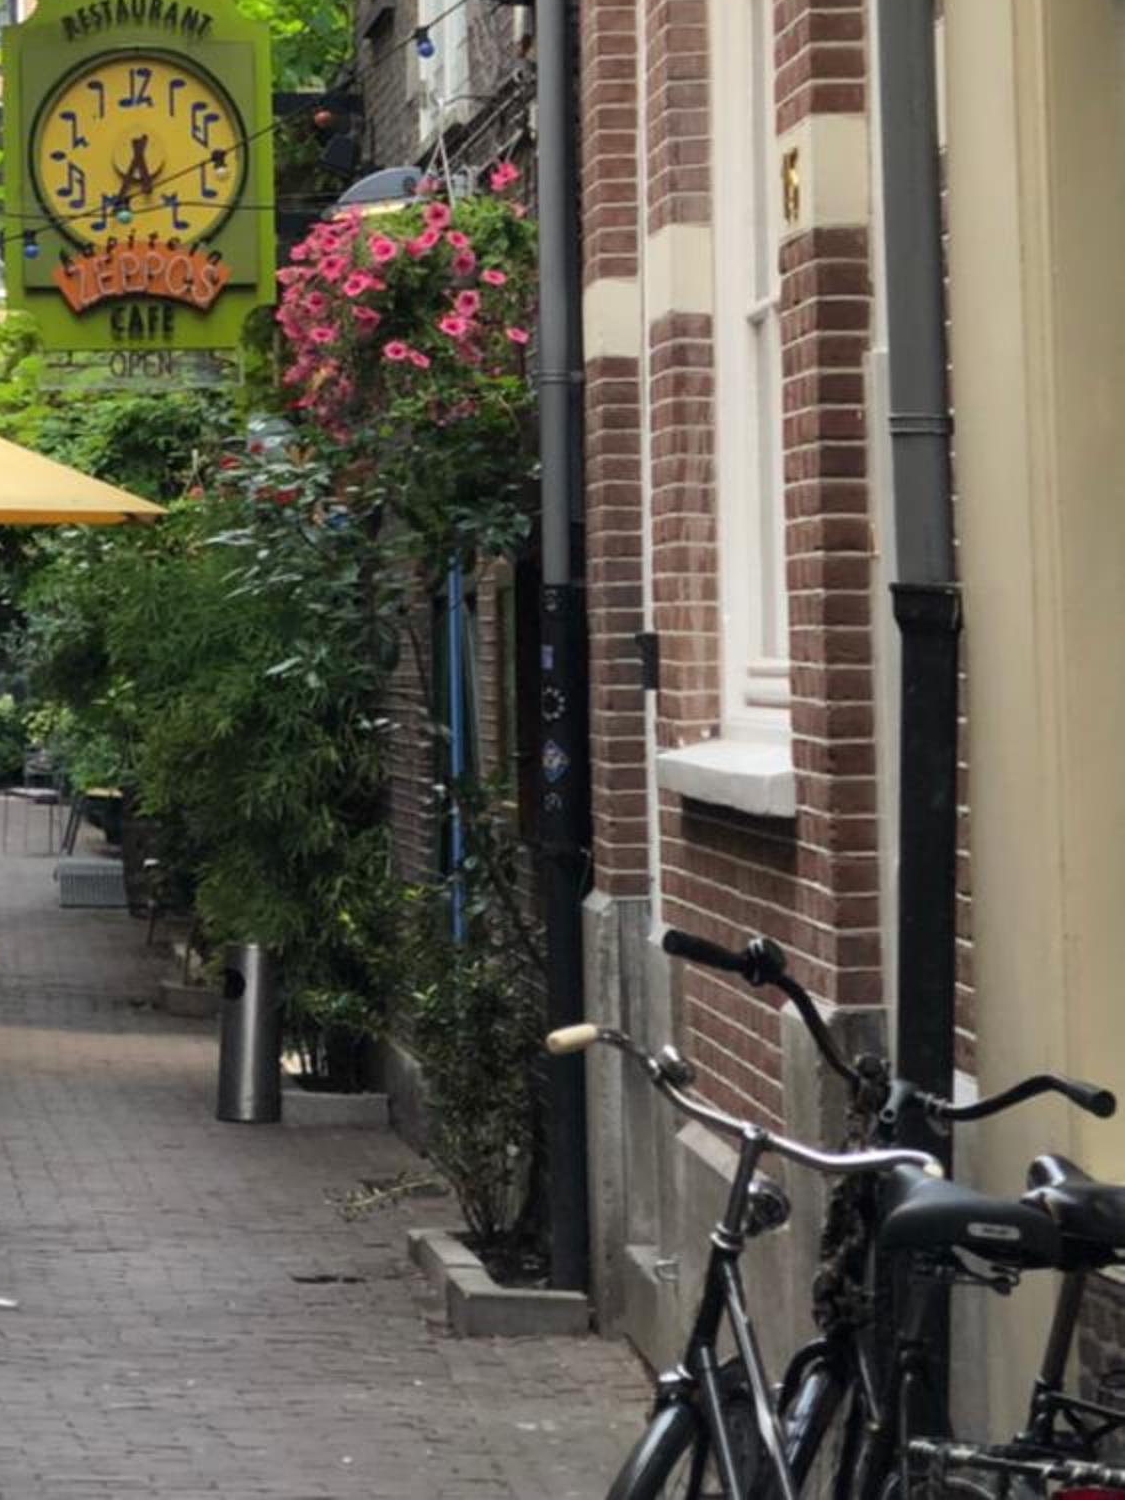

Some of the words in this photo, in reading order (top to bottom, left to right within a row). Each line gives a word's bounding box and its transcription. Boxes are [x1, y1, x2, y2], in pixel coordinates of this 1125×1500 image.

[67, 251, 216, 306] ZEPPOS
[111, 301, 174, 340] CAFE
[109, 352, 173, 378] OPEN
